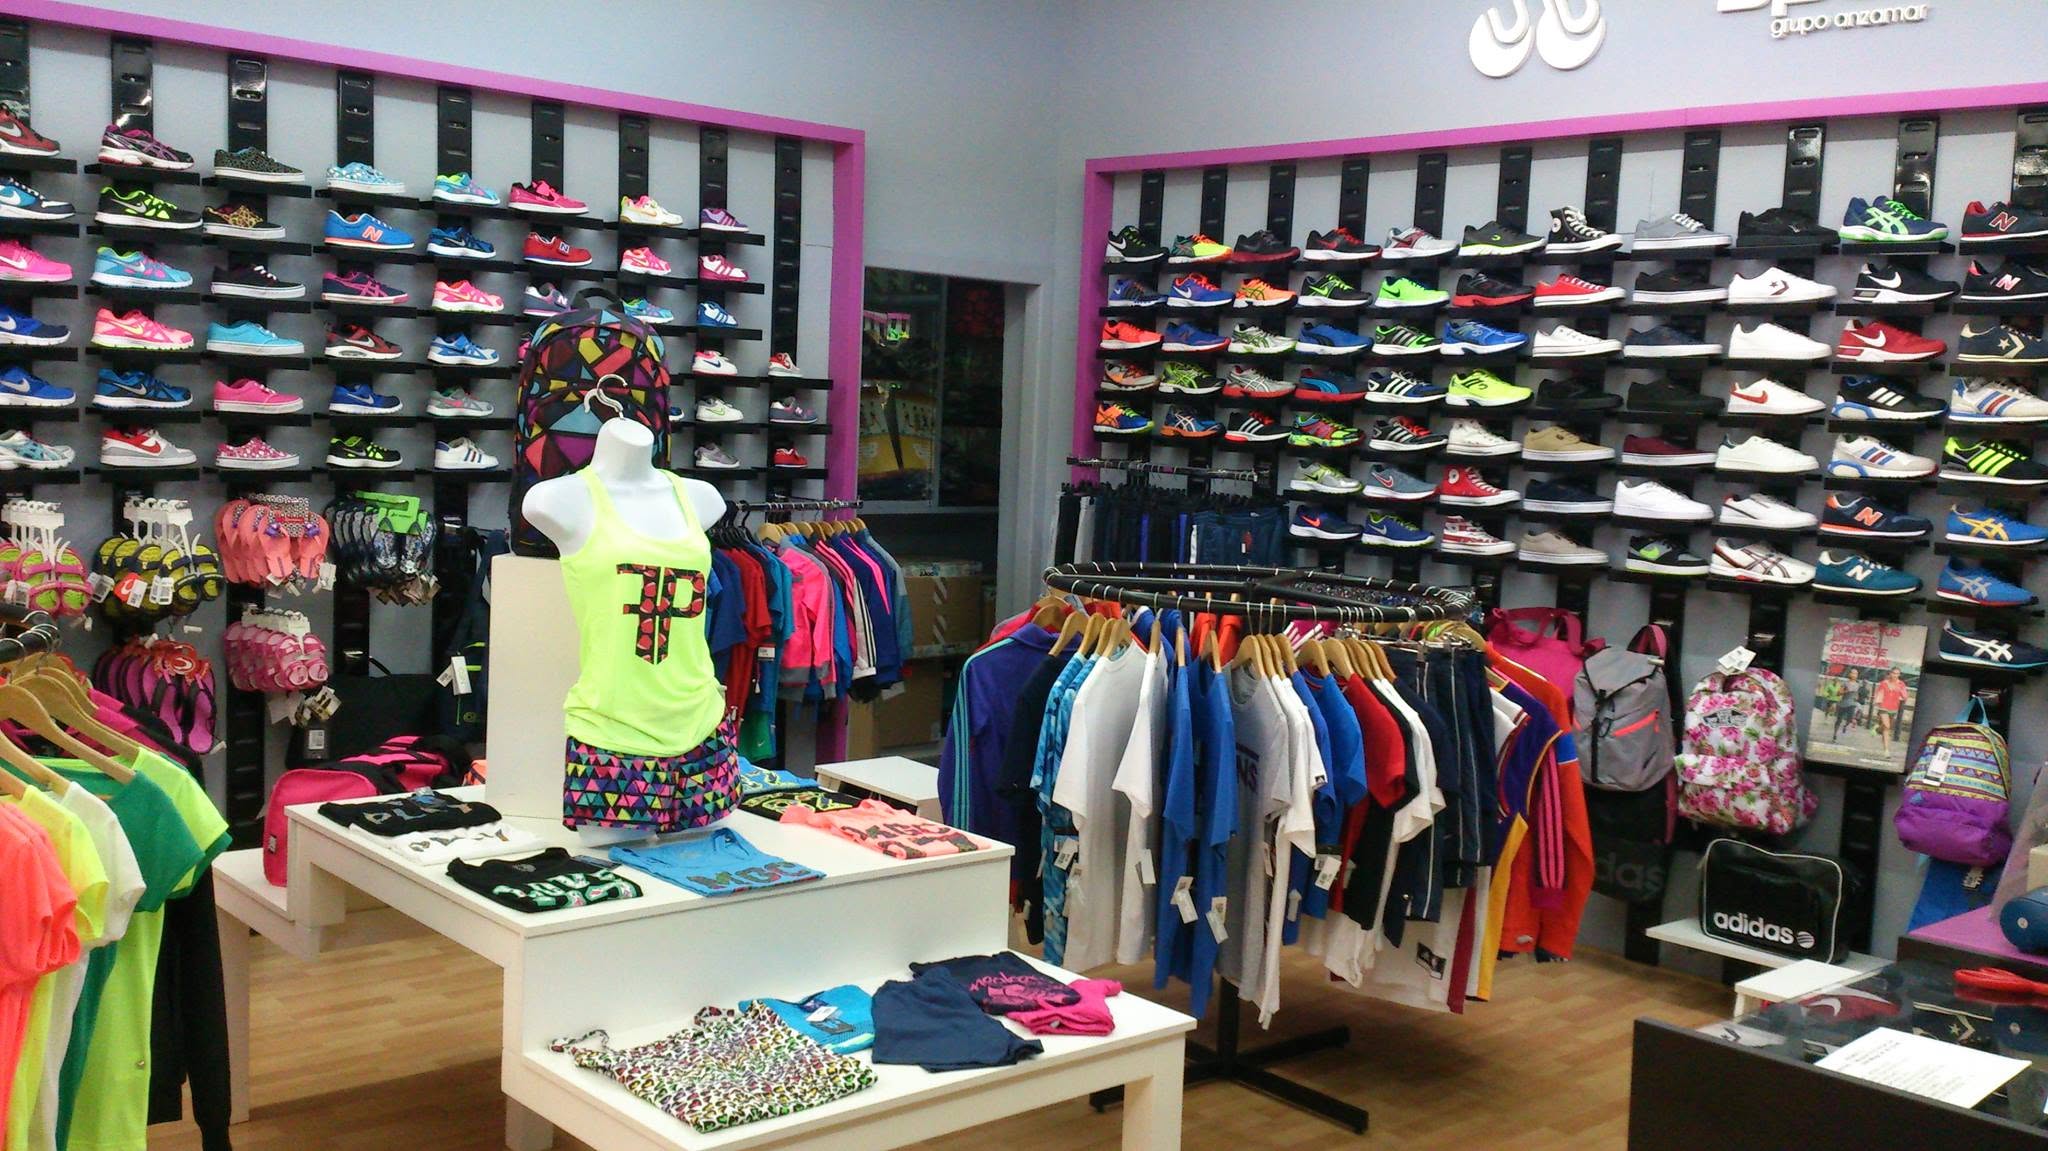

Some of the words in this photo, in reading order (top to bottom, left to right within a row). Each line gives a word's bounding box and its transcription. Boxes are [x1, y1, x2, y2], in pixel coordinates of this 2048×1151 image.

[1770, 14, 1829, 39] grupo
[1834, 4, 1929, 28] anzamar
[1713, 911, 1795, 945] adidas
